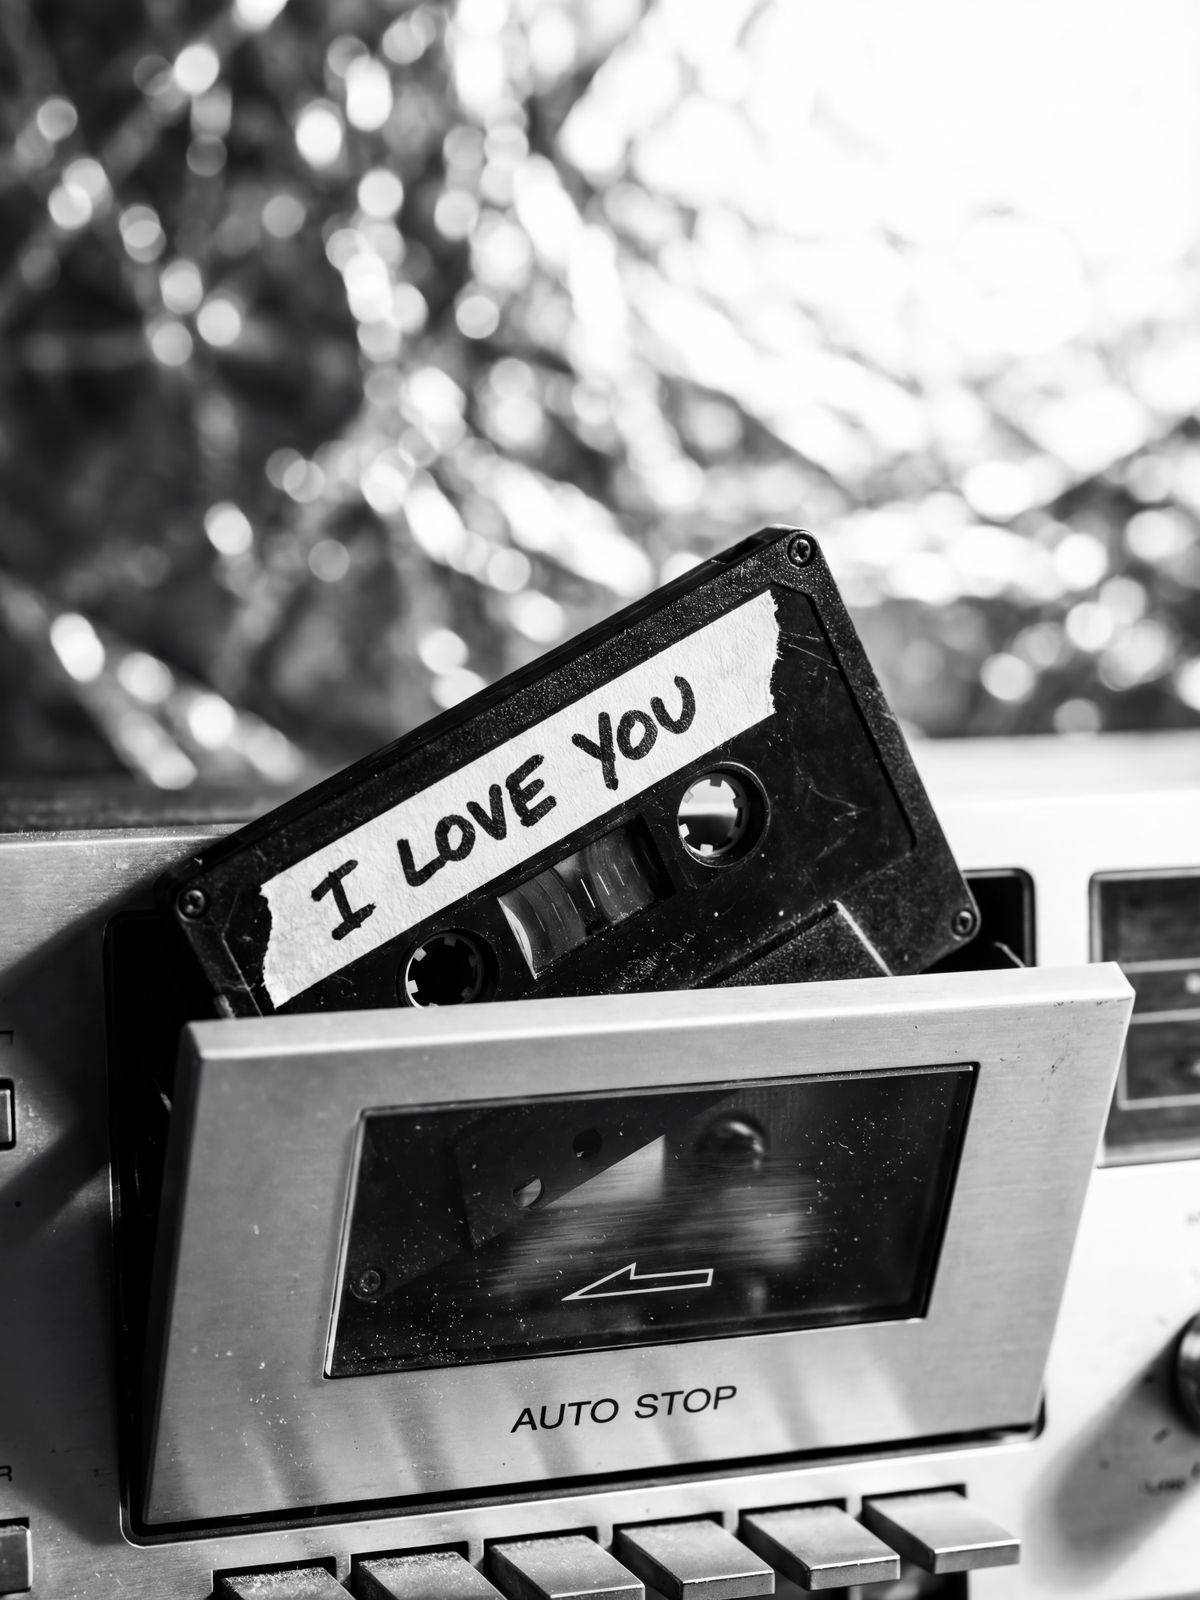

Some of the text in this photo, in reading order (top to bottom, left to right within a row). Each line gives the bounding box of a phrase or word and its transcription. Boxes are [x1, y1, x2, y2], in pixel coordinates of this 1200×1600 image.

[310, 675, 696, 941] I LOVE YOU
[510, 1385, 737, 1434] AUTO STOP
